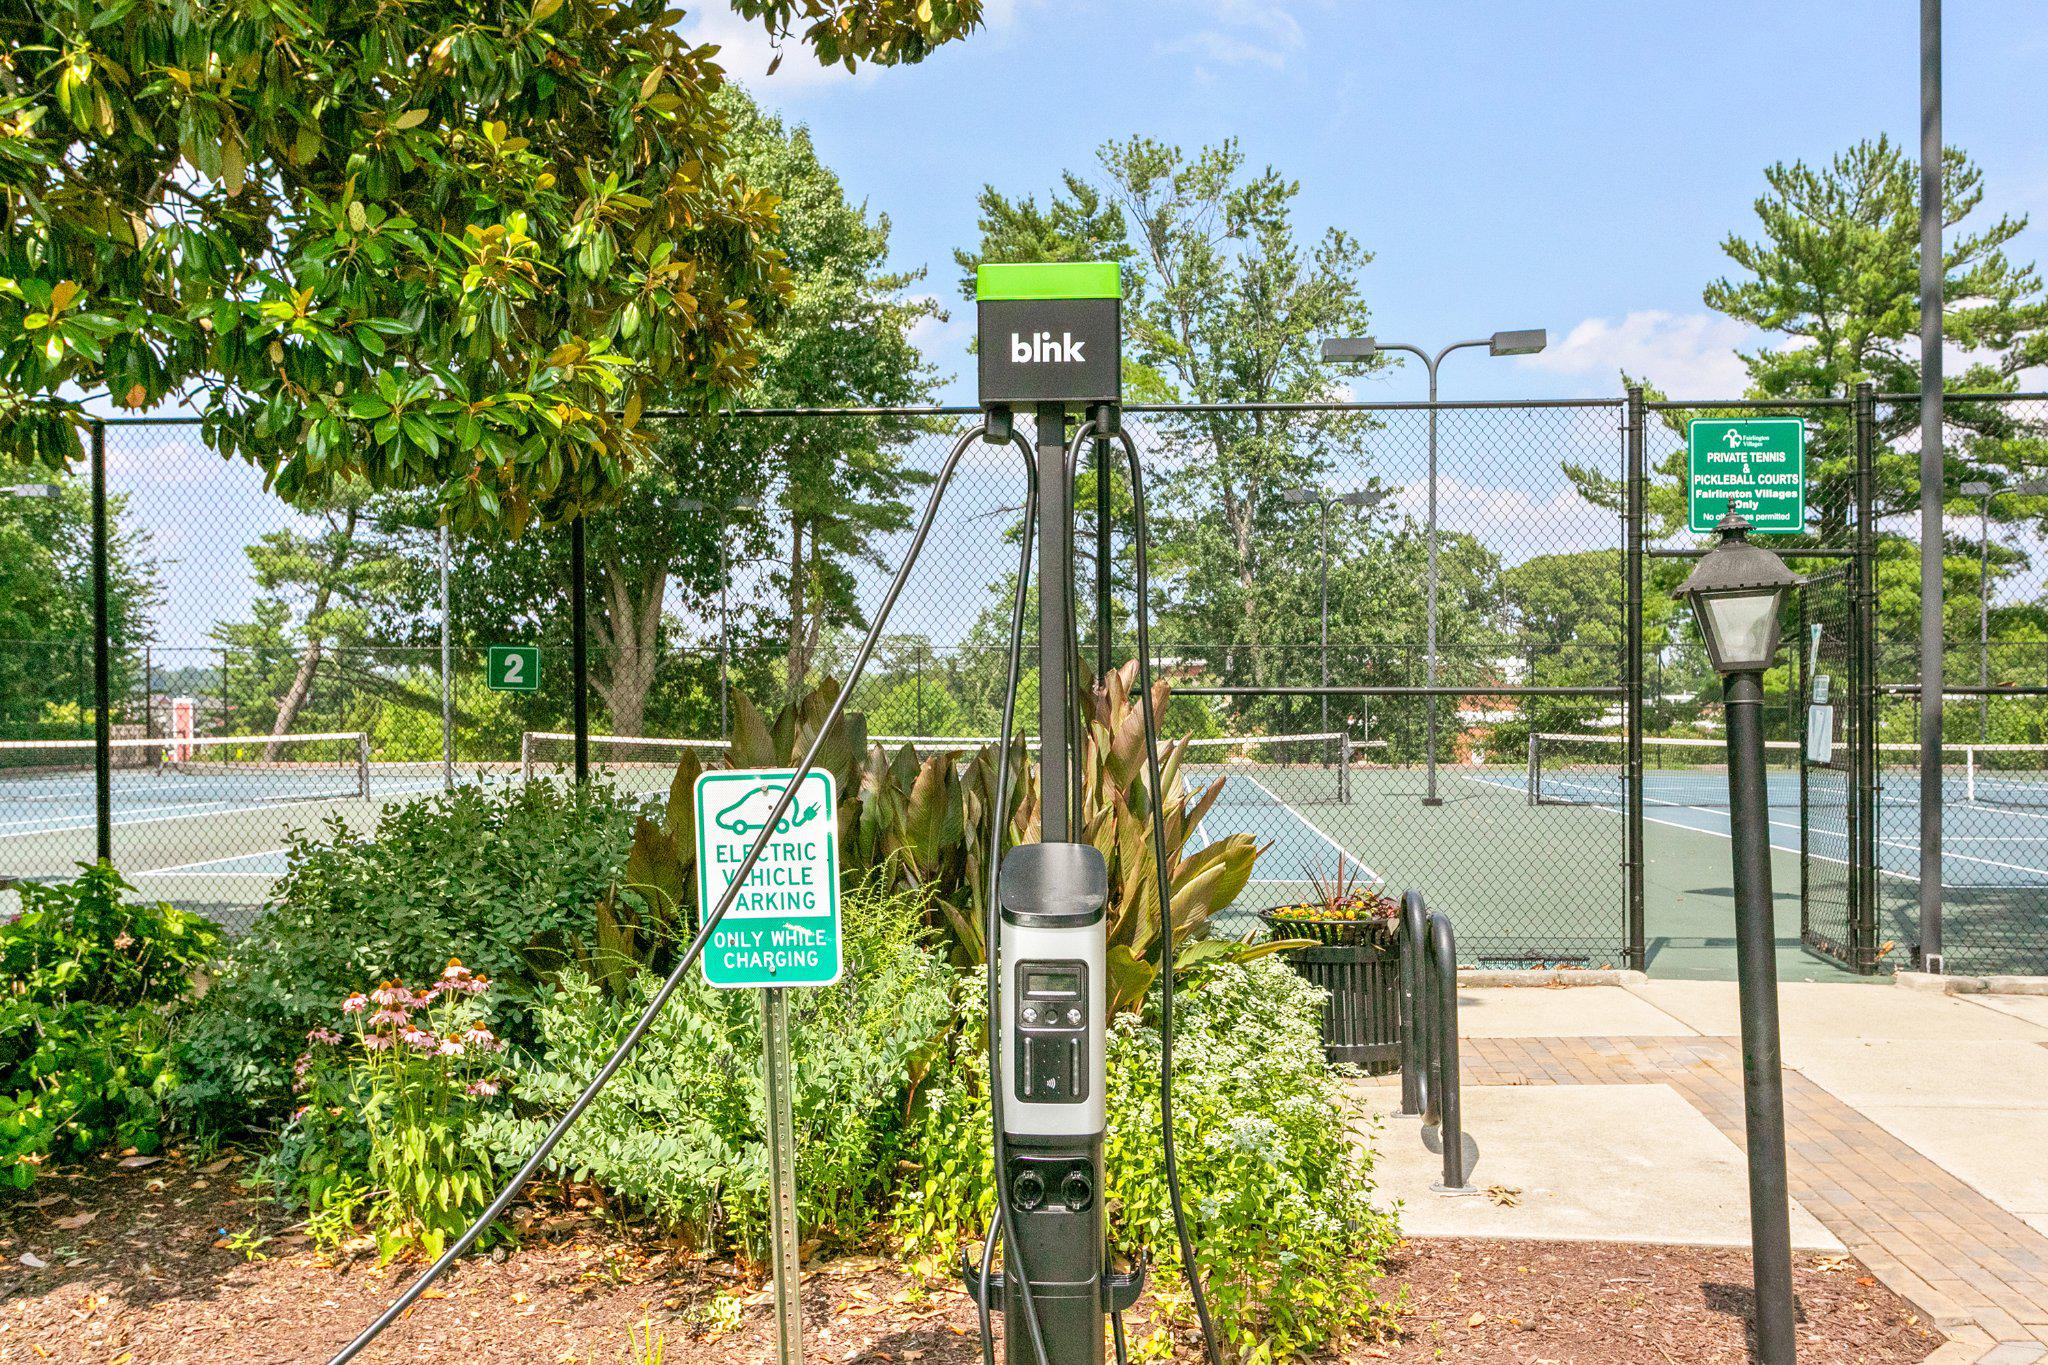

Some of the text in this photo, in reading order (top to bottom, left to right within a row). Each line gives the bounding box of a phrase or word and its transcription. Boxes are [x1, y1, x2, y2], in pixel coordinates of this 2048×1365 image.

[1011, 331, 1086, 363] blink
[1707, 452, 1786, 462] PRIVATE TENNIS
[1742, 463, 1750, 473] &
[1694, 474, 1799, 485] PICKLEBALL COURTS
[1754, 489, 1798, 500] Villages
[1735, 500, 1759, 510] Only
[1703, 513, 1714, 521] No
[1755, 513, 1790, 521] permitted
[503, 653, 524, 683] 2
[722, 867, 814, 887] VHICLE
[723, 891, 816, 911] ARKING
[713, 929, 827, 948] ONLY WHILE
[723, 950, 819, 969] CHARGING
